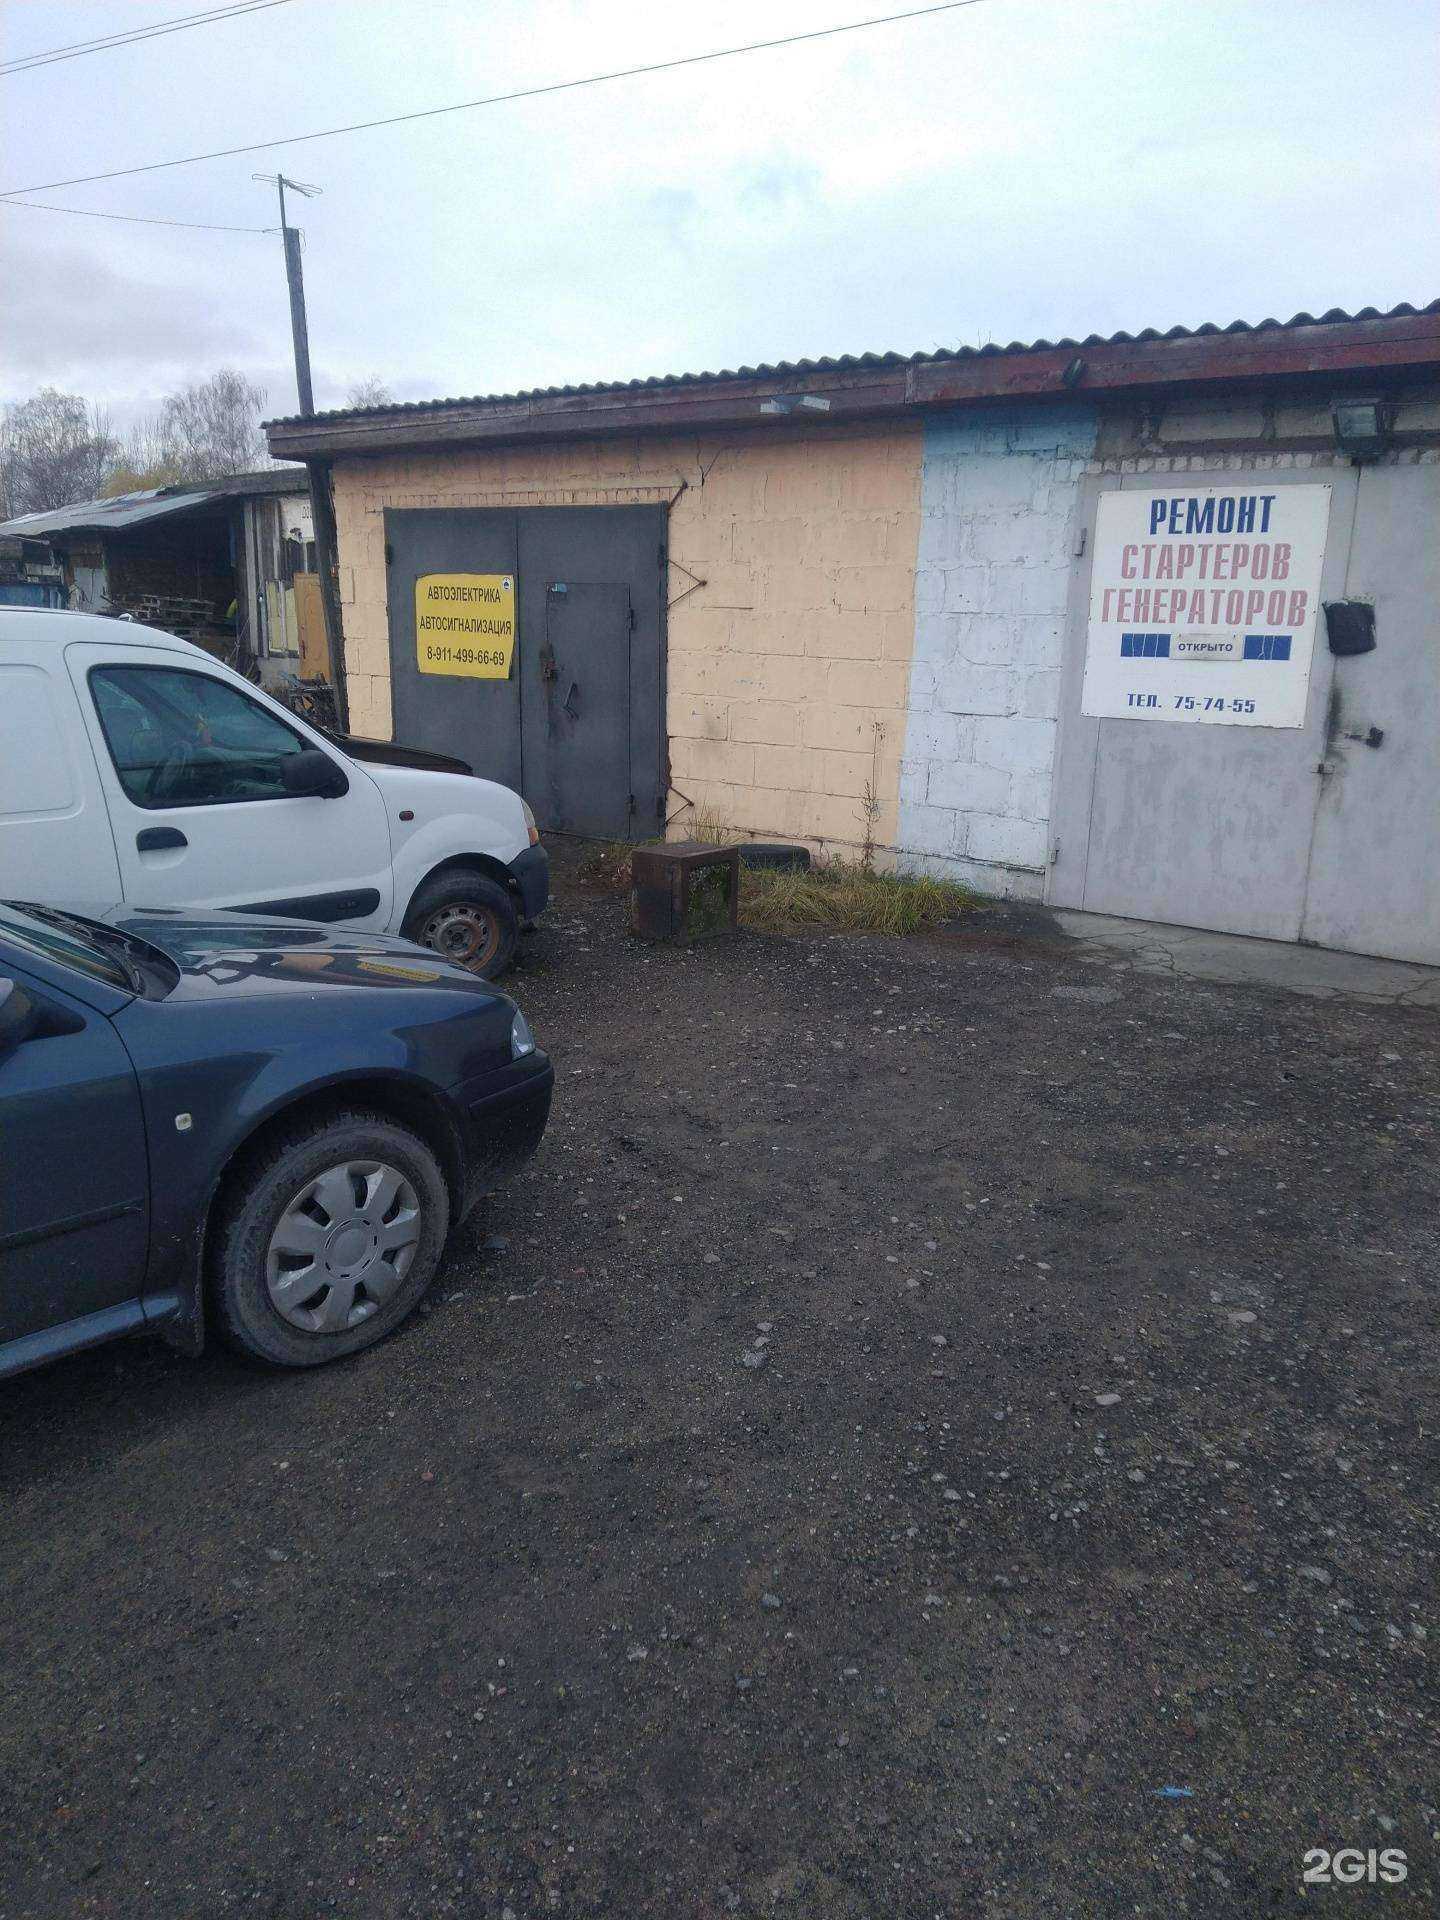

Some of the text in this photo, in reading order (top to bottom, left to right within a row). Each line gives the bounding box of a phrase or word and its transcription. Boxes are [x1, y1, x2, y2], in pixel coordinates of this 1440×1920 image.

[1149, 495, 1276, 535] РЕМОНТ
[1121, 542, 1292, 581] СТАРТЕРОВ
[427, 585, 501, 603] АВТОЭЛЕКТРИКА
[1101, 588, 1309, 627] ГЕНЕРАТОРОВ
[419, 615, 512, 637] АВТОСИГНАЛИЗАЦИЯ
[427, 646, 505, 666] 8-911-499-66-69
[1178, 642, 1233, 653] ОТКРЫТО
[1174, 695, 1256, 713] 75-74-55
